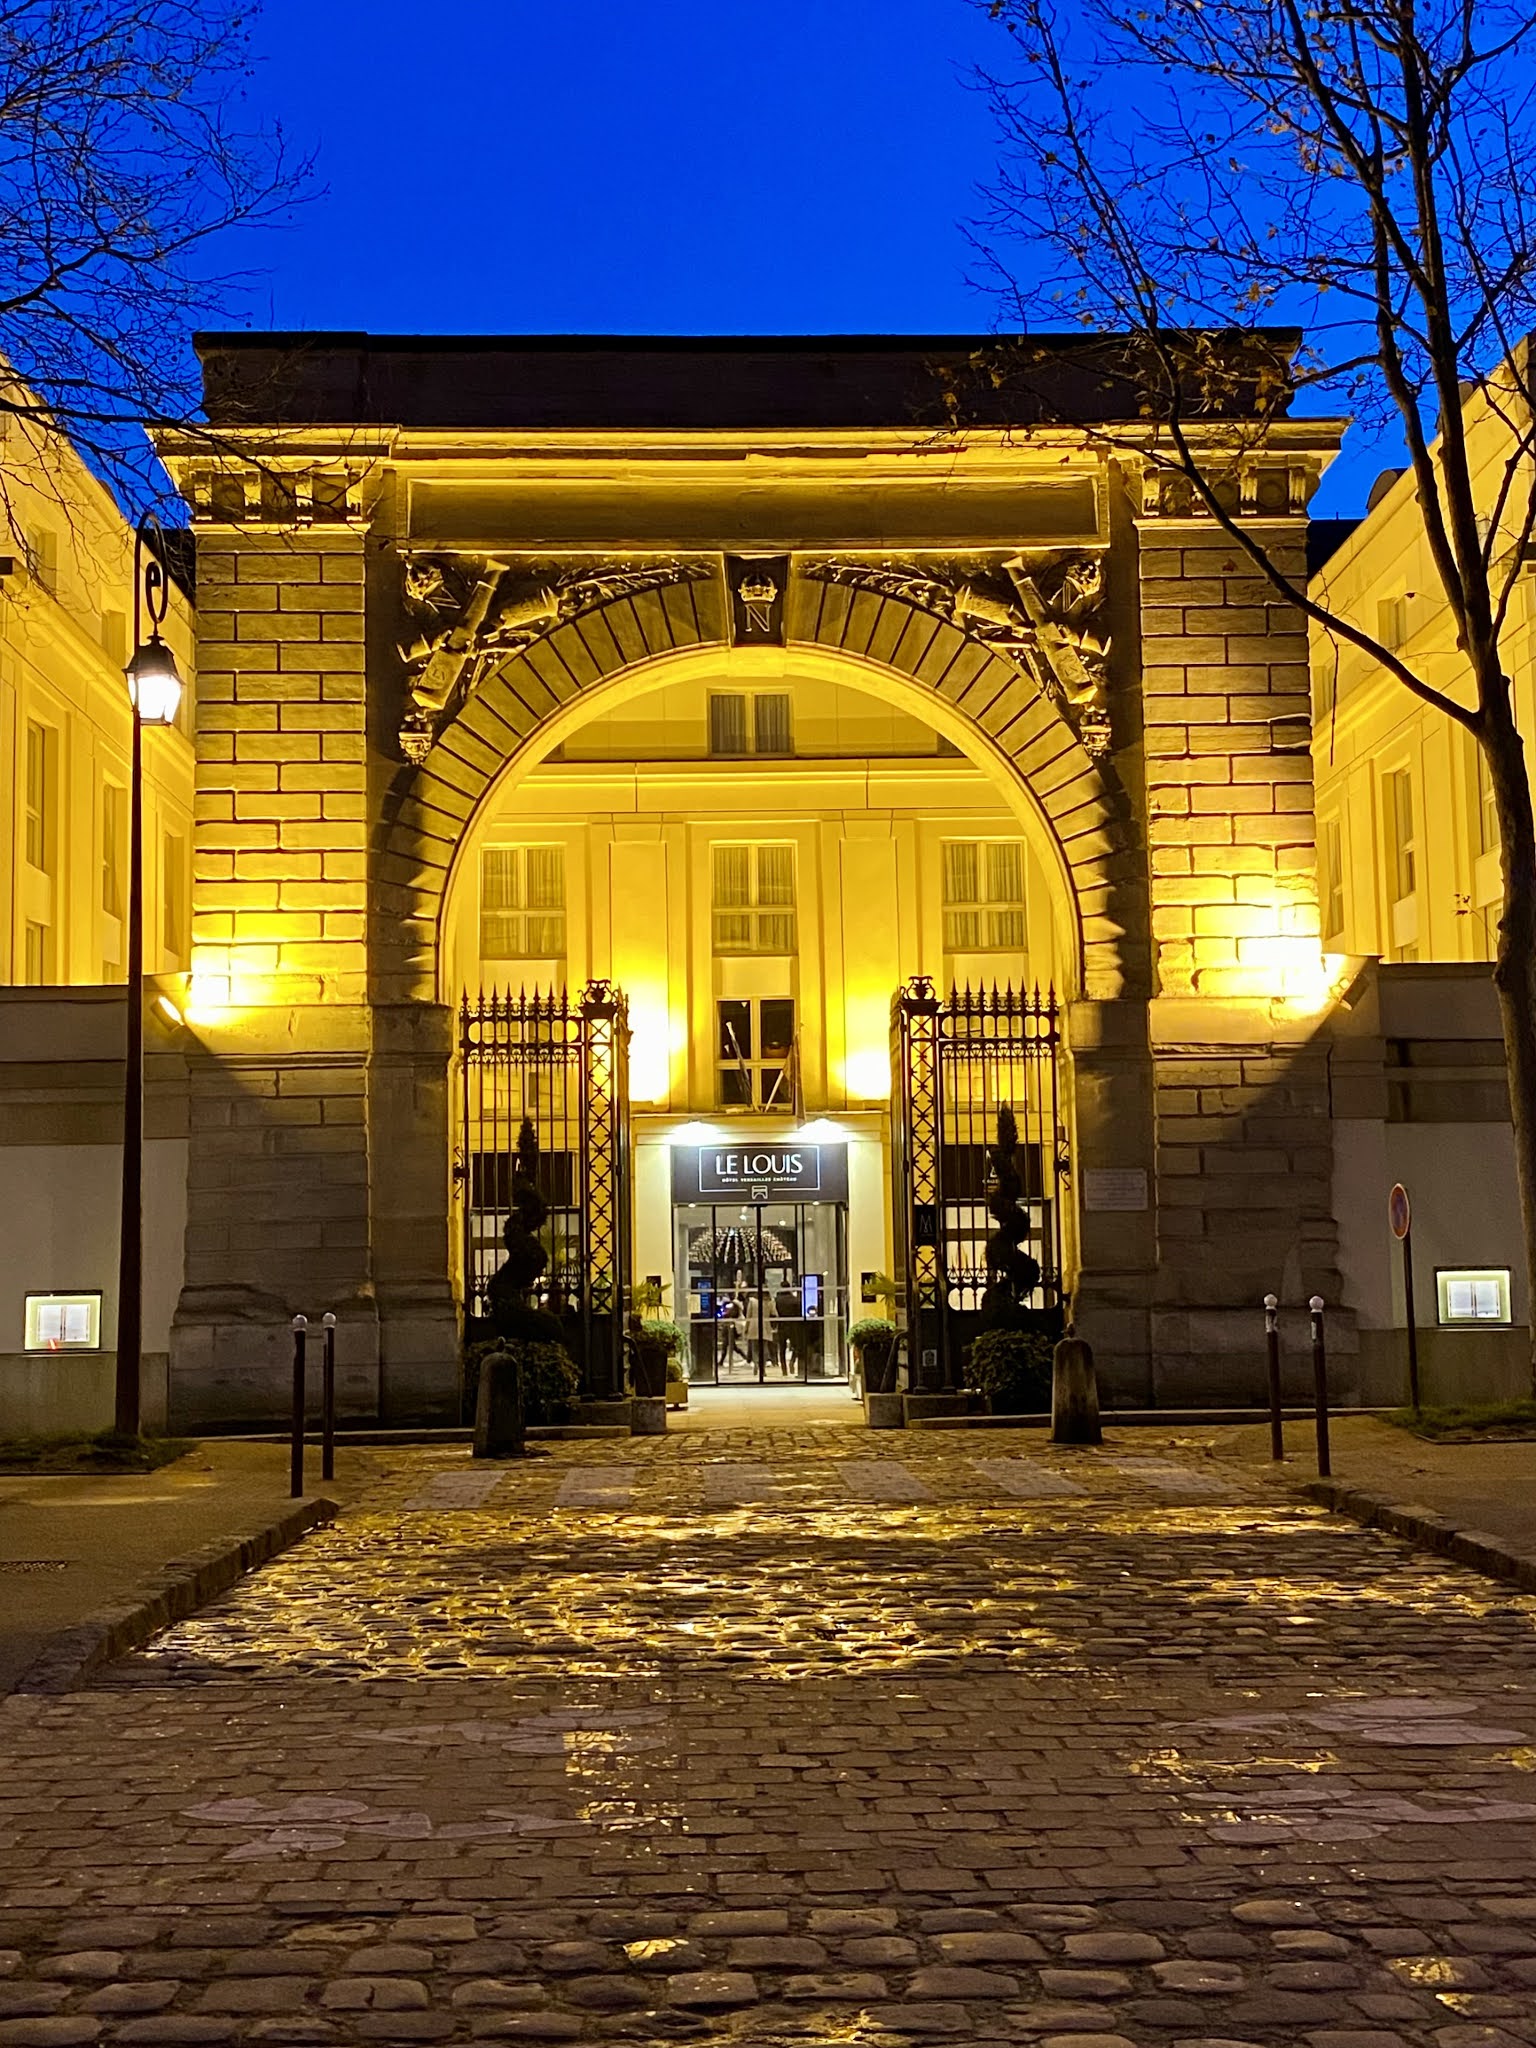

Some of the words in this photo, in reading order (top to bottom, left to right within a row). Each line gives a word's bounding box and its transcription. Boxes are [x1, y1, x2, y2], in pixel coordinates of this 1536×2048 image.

[744, 603, 772, 632] N
[715, 1154, 739, 1175] LE
[743, 1153, 803, 1174] LOUIS
